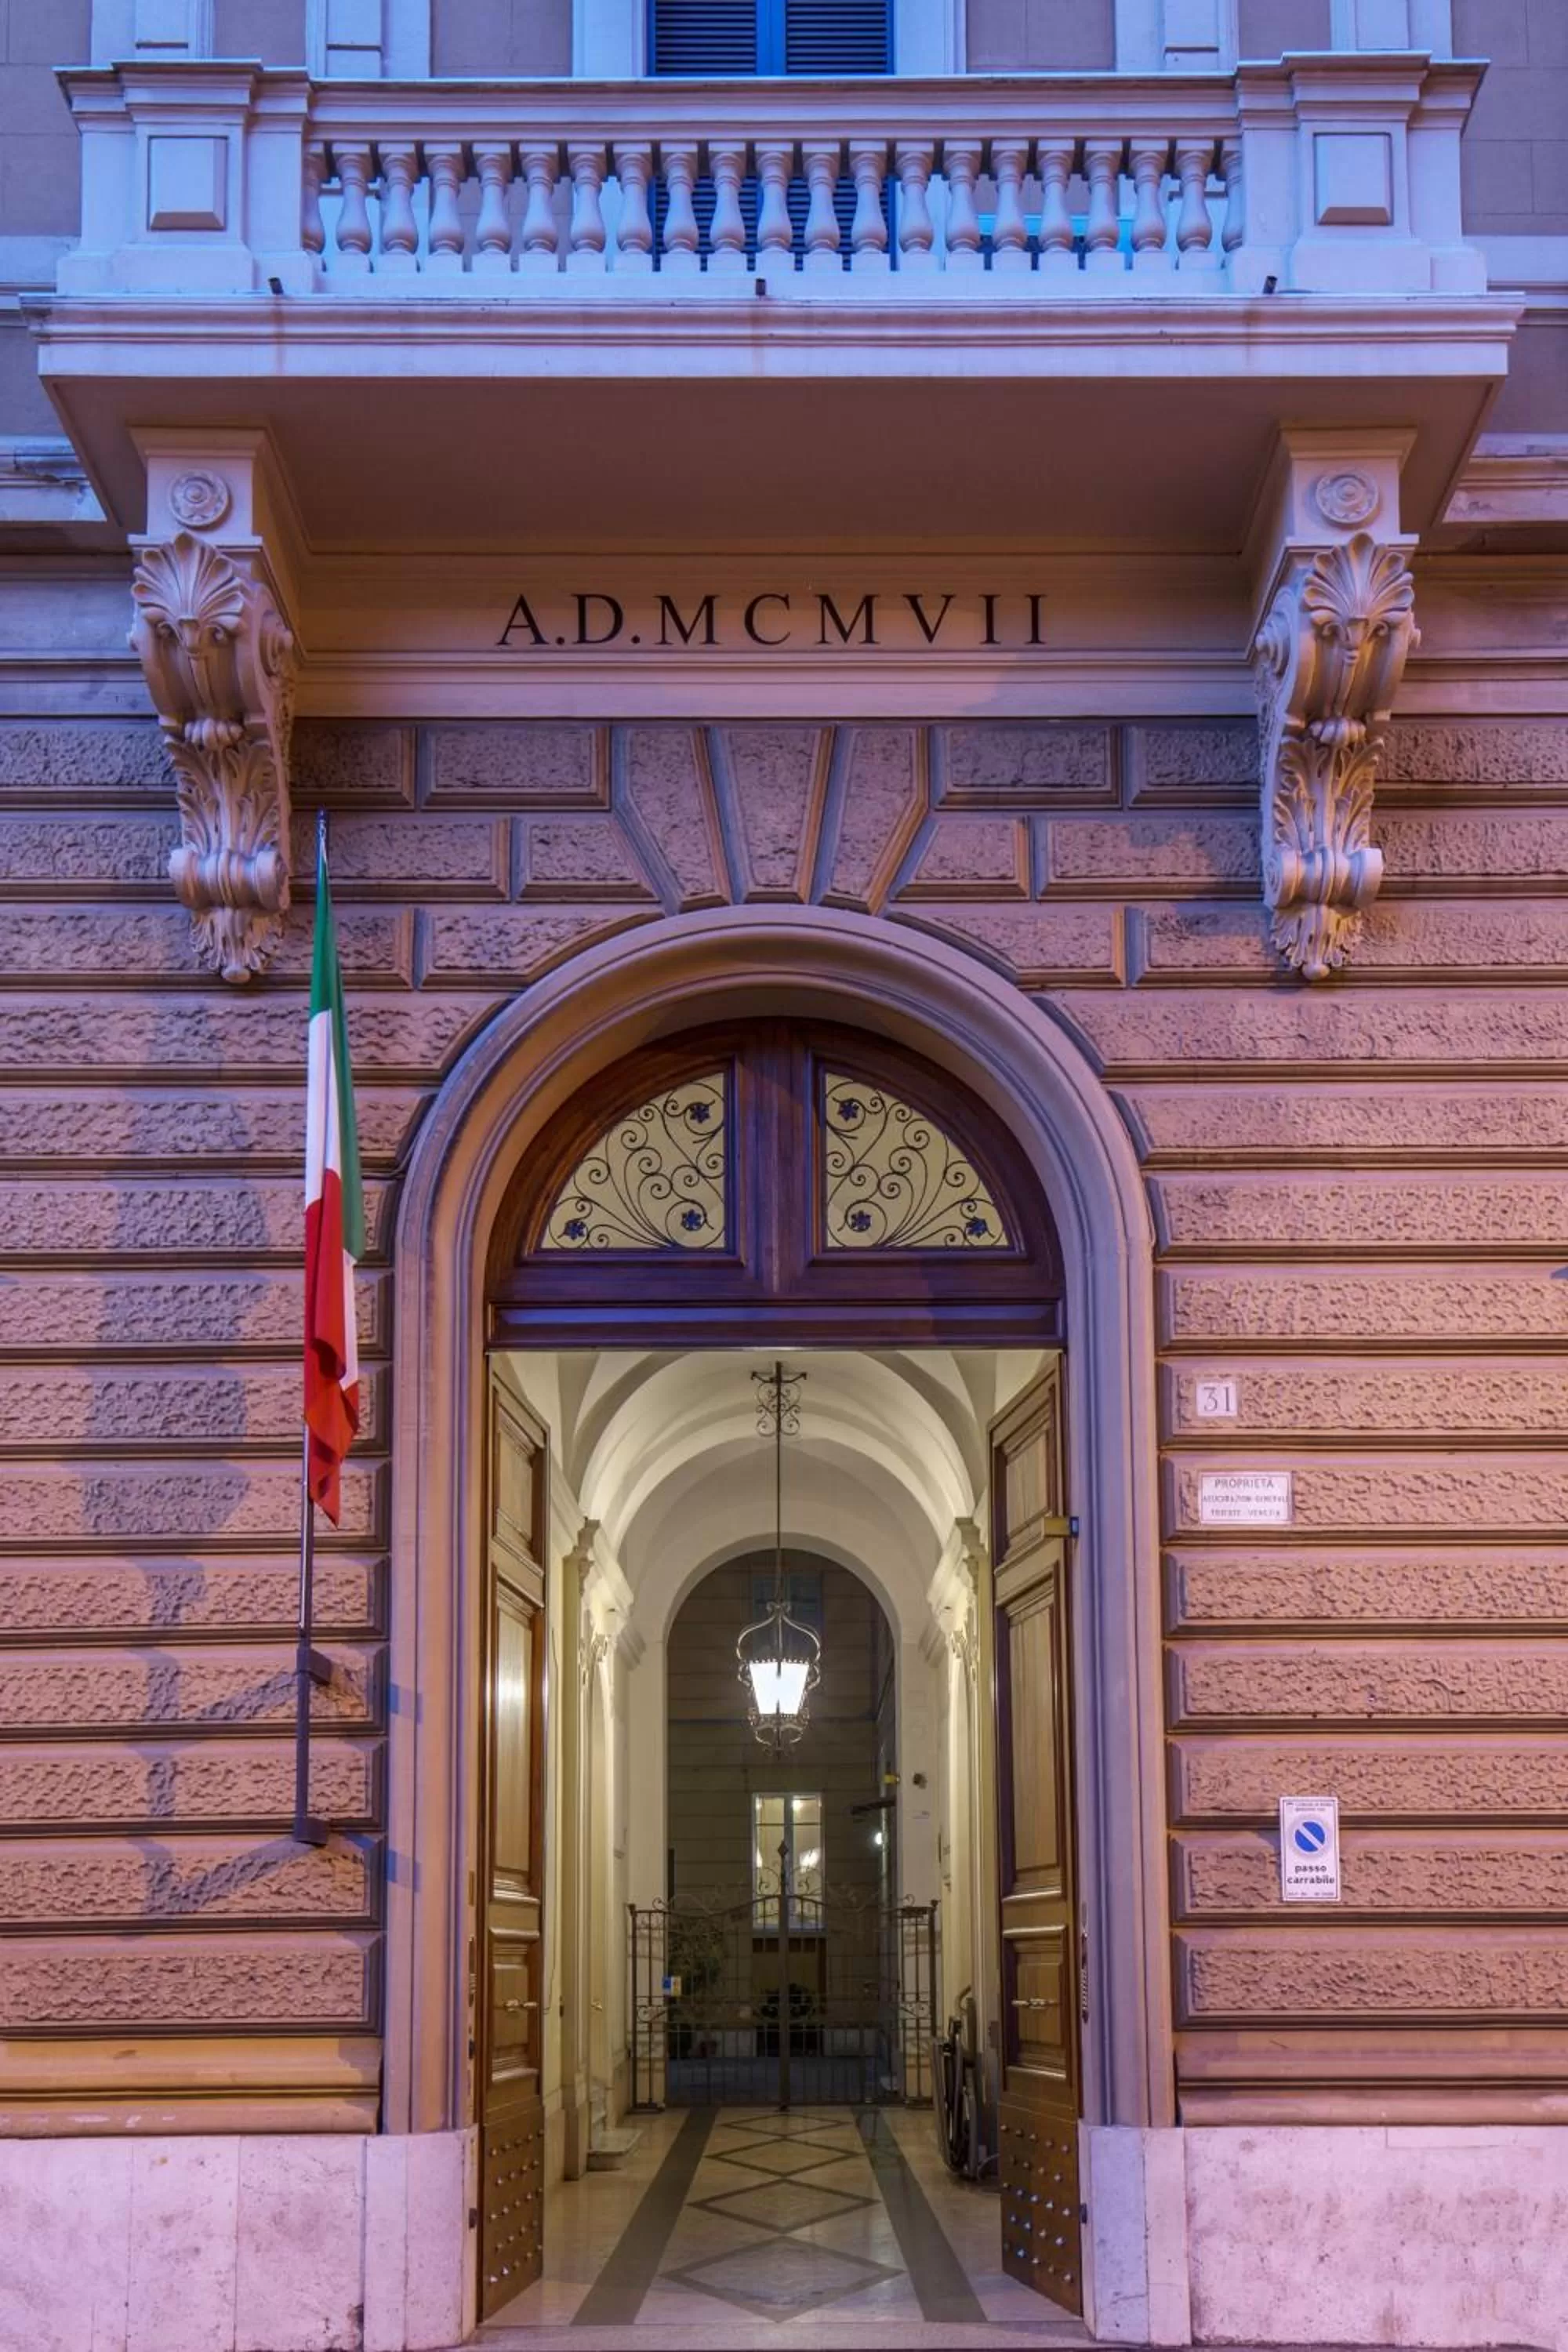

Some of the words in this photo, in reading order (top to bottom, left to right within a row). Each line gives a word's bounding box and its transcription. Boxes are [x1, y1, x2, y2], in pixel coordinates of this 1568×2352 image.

[1203, 1386, 1231, 1412] 31
[1294, 1865, 1327, 1874] passo
[1287, 1875, 1335, 1884] carrabile
